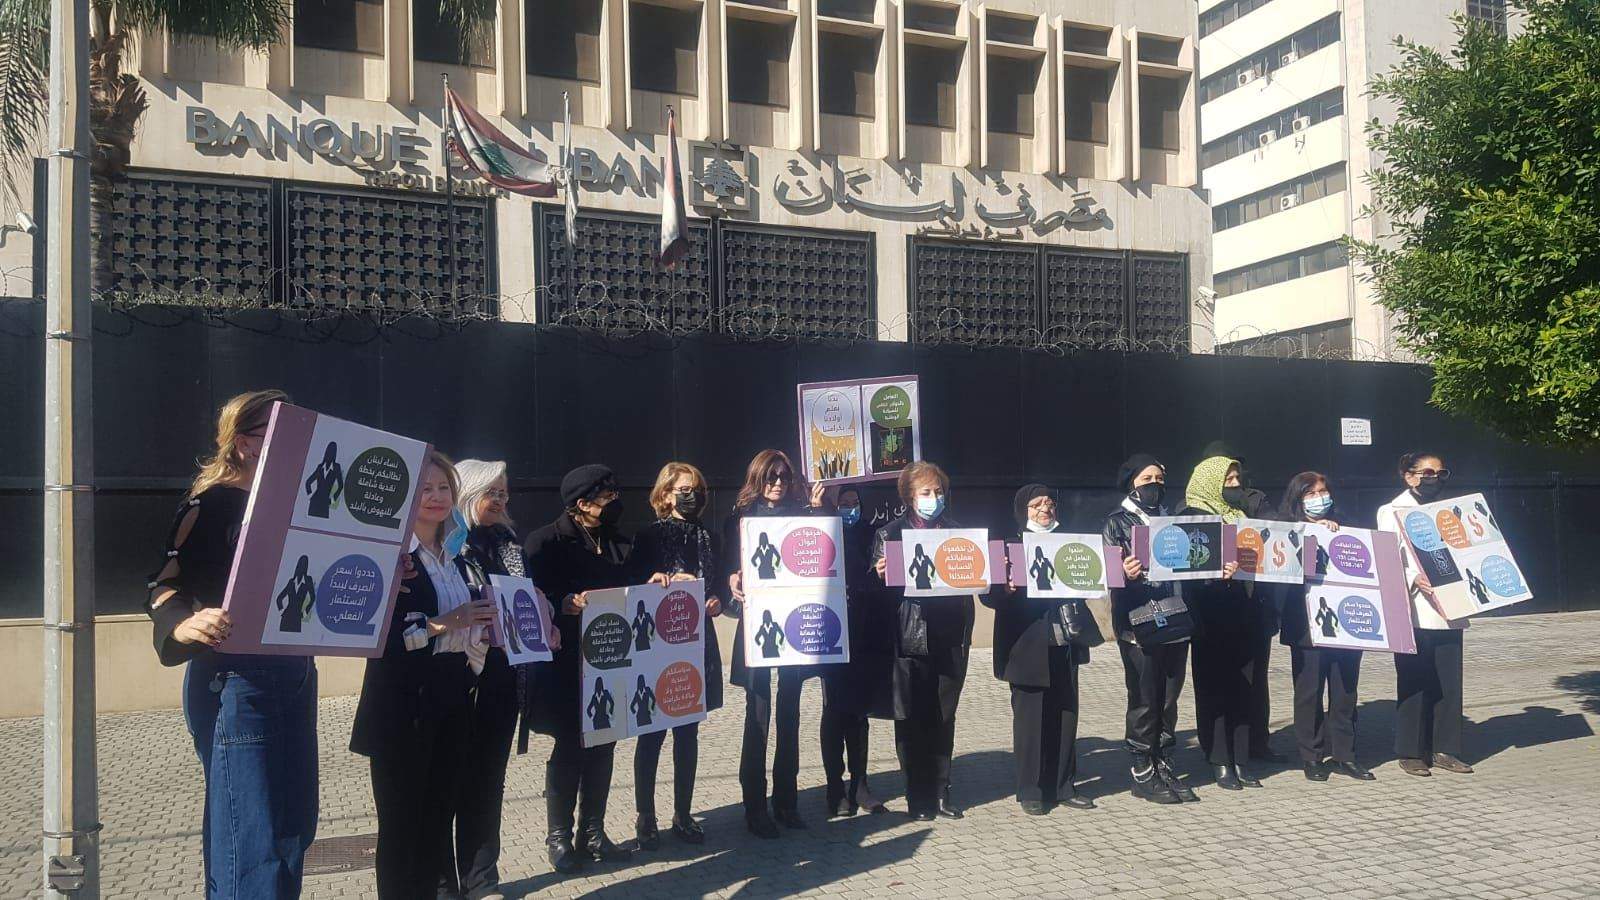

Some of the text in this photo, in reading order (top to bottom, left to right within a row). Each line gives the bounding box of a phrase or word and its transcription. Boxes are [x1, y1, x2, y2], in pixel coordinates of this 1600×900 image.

[186, 105, 424, 163] BANQUE
[528, 141, 668, 195] IBAN
[364, 170, 432, 191] TRIPOLI
[773, 159, 1114, 237] مصرف لبنان
[367, 455, 399, 468] نساء لبنان
[359, 464, 401, 481] نطالبكم بخطة
[358, 477, 396, 492] نقدية شاملة
[364, 491, 384, 503] وعادلة
[349, 501, 392, 517] للنهوض بالبلد
[799, 536, 817, 546] أموال
[792, 547, 822, 556] المودعين
[797, 556, 819, 565] للعيش
[333, 566, 375, 578] حددوا سعر
[798, 566, 818, 576] الكريم
[349, 583, 375, 593] الصرف
[328, 593, 367, 607] الاستثمار
